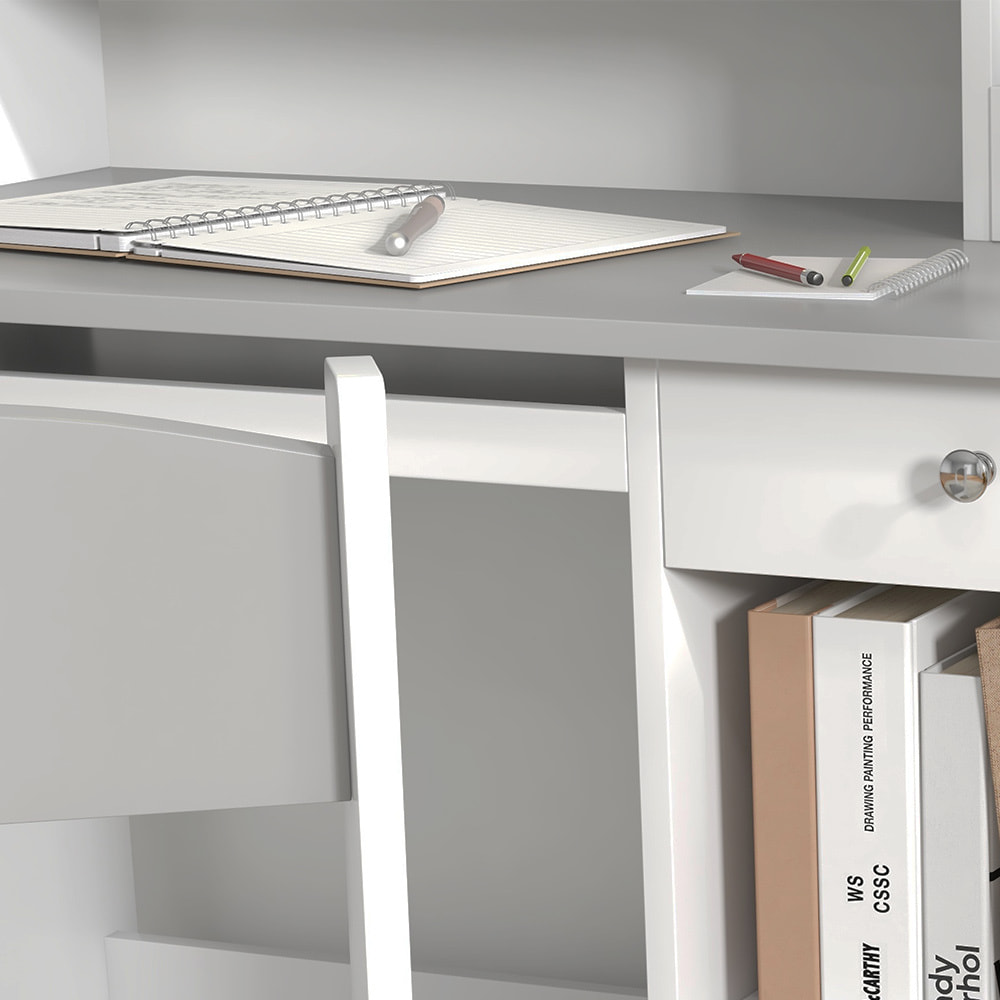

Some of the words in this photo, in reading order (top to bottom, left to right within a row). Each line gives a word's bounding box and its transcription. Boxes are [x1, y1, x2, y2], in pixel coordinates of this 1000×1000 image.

[861, 652, 874, 732] PERFORMANCE
[862, 735, 875, 782] PAINTING
[863, 784, 875, 833] DRAWING
[847, 875, 864, 902] WS
[872, 864, 891, 914] CSSC
